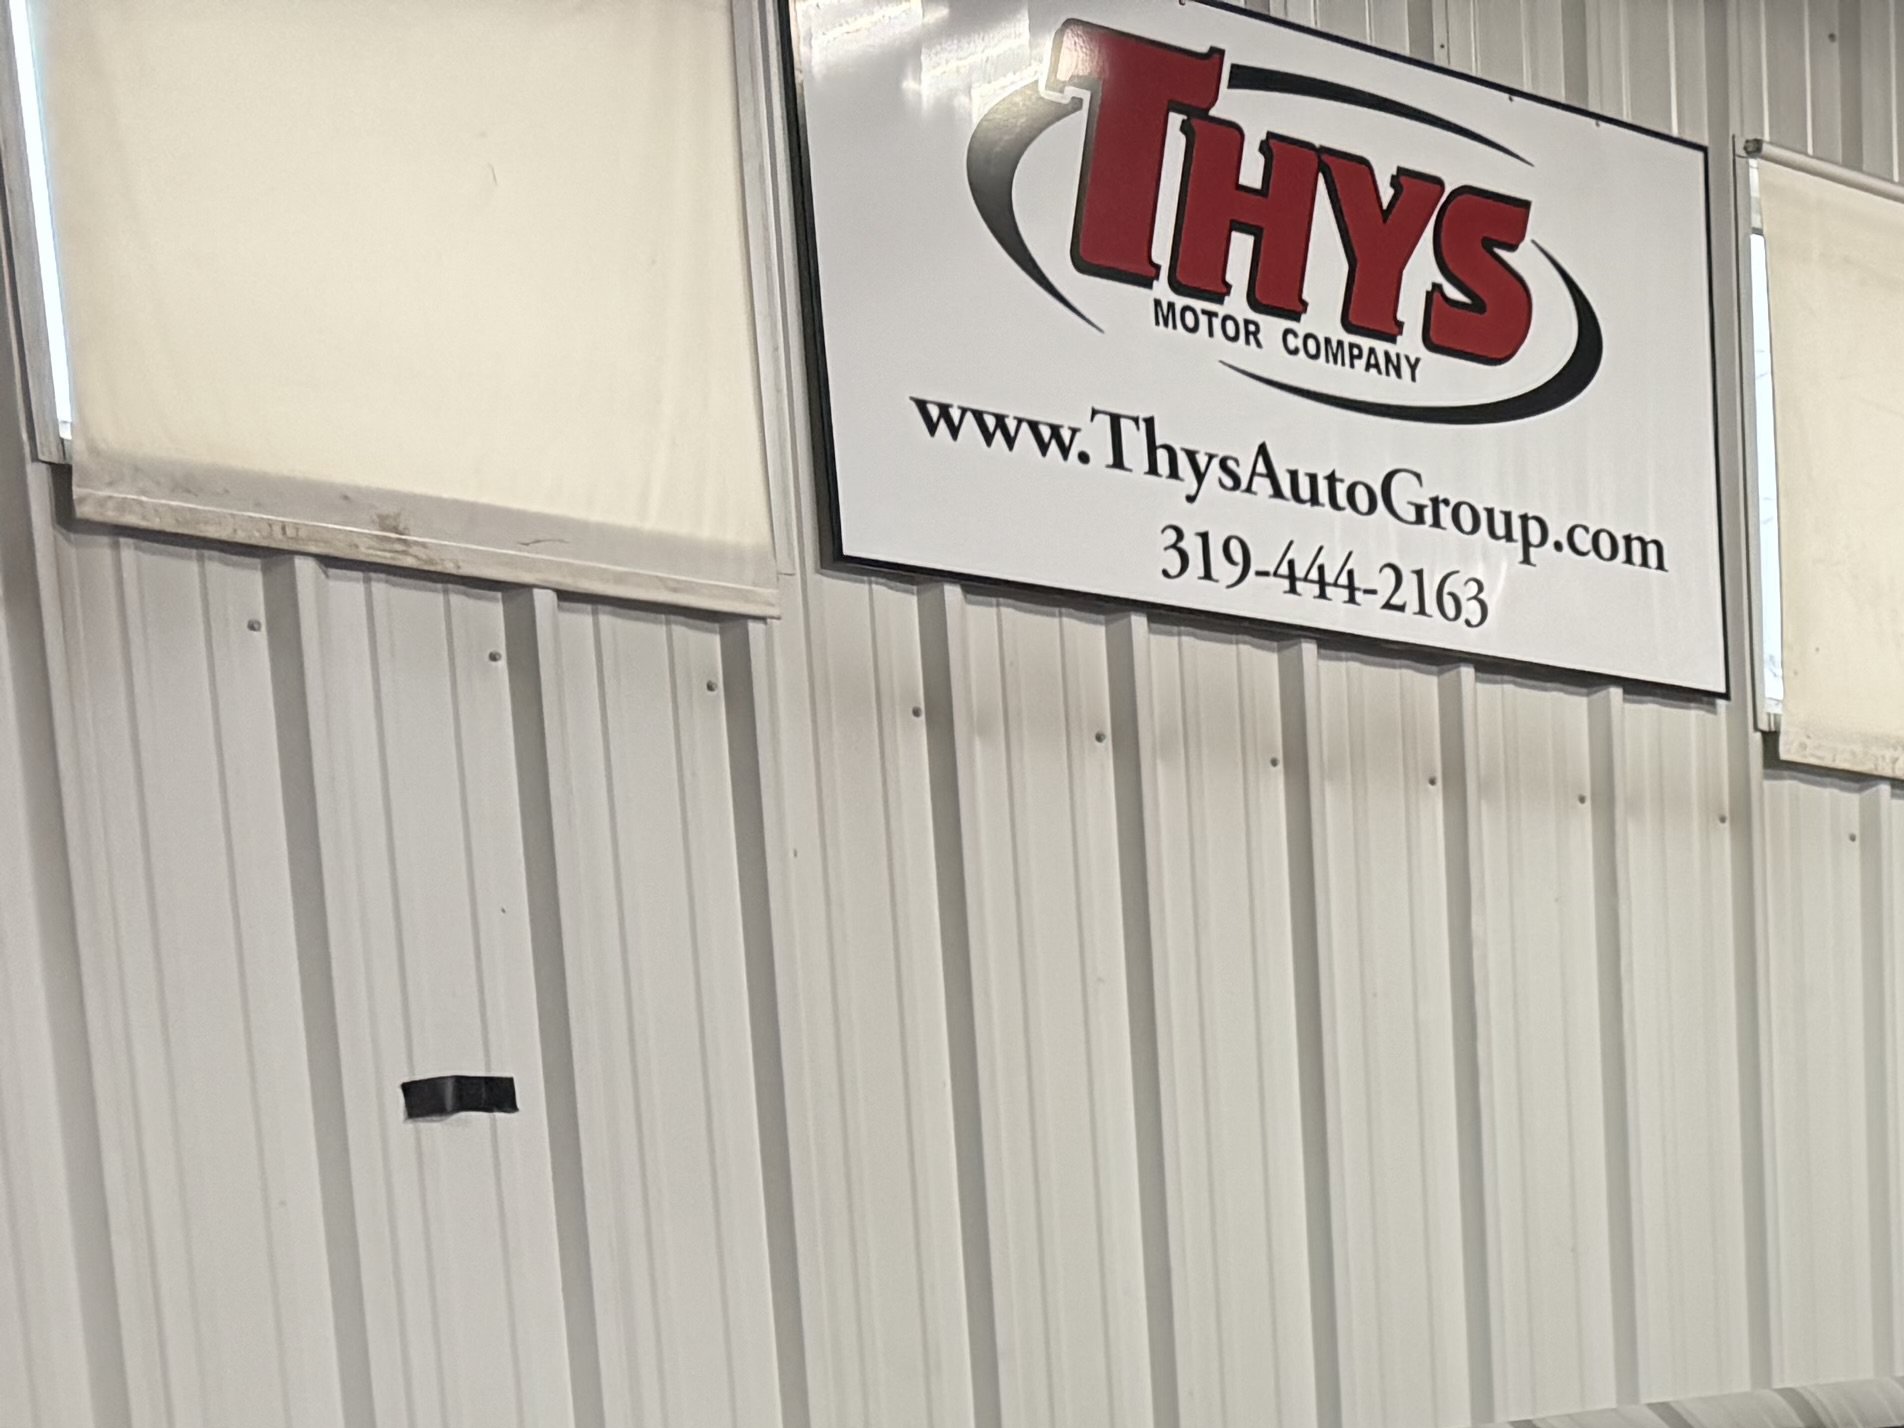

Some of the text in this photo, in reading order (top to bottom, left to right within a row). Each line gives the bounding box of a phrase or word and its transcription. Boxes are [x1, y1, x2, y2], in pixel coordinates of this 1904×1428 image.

[1047, 18, 1533, 367] THYS
[1152, 297, 1423, 384] MOTOR COMPANY
[908, 395, 1668, 571] www.ThysAutoGroup.com
[1159, 524, 1491, 629] 319-444-2163
